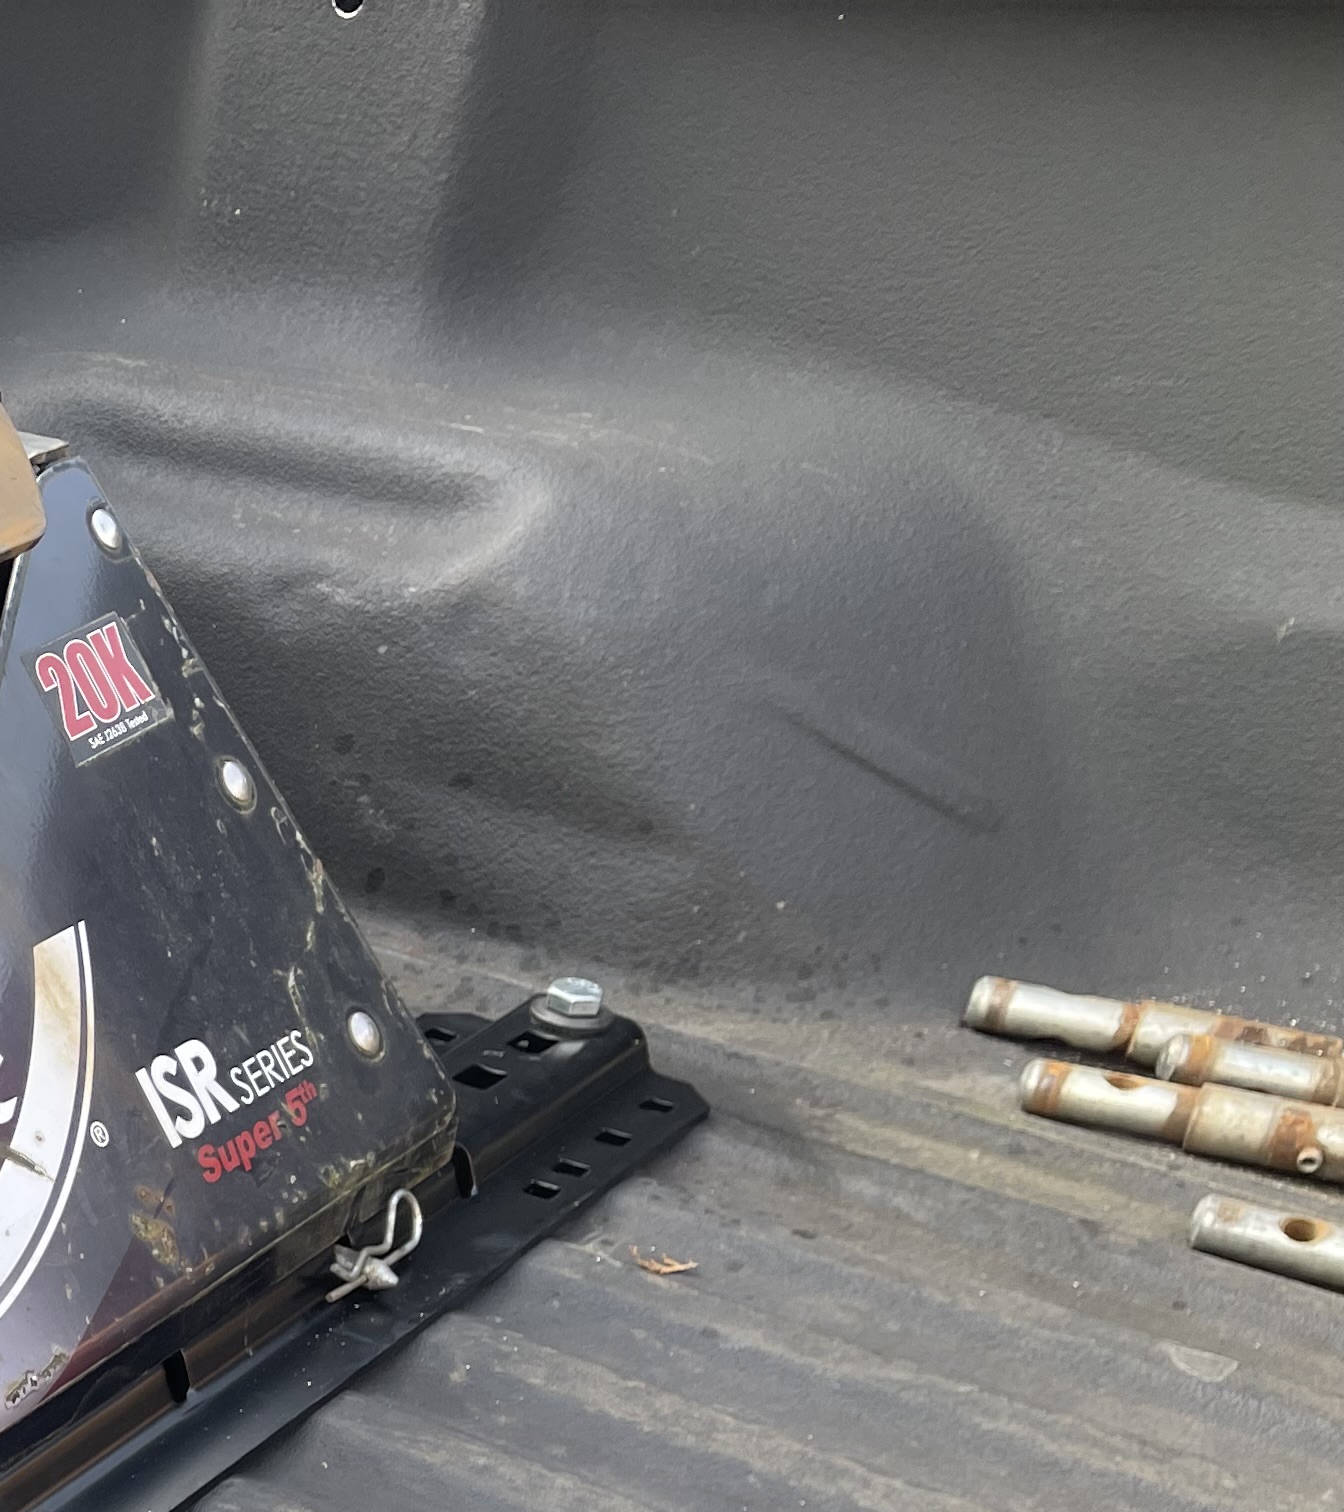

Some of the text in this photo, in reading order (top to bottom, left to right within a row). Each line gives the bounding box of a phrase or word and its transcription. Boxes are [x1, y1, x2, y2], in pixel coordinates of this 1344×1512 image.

[35, 621, 156, 741] 20K
[88, 733, 106, 749] SAE
[124, 711, 149, 729] Tested
[134, 1029, 314, 1149] ISR SERIES
[198, 1079, 318, 1183] Super 5th
